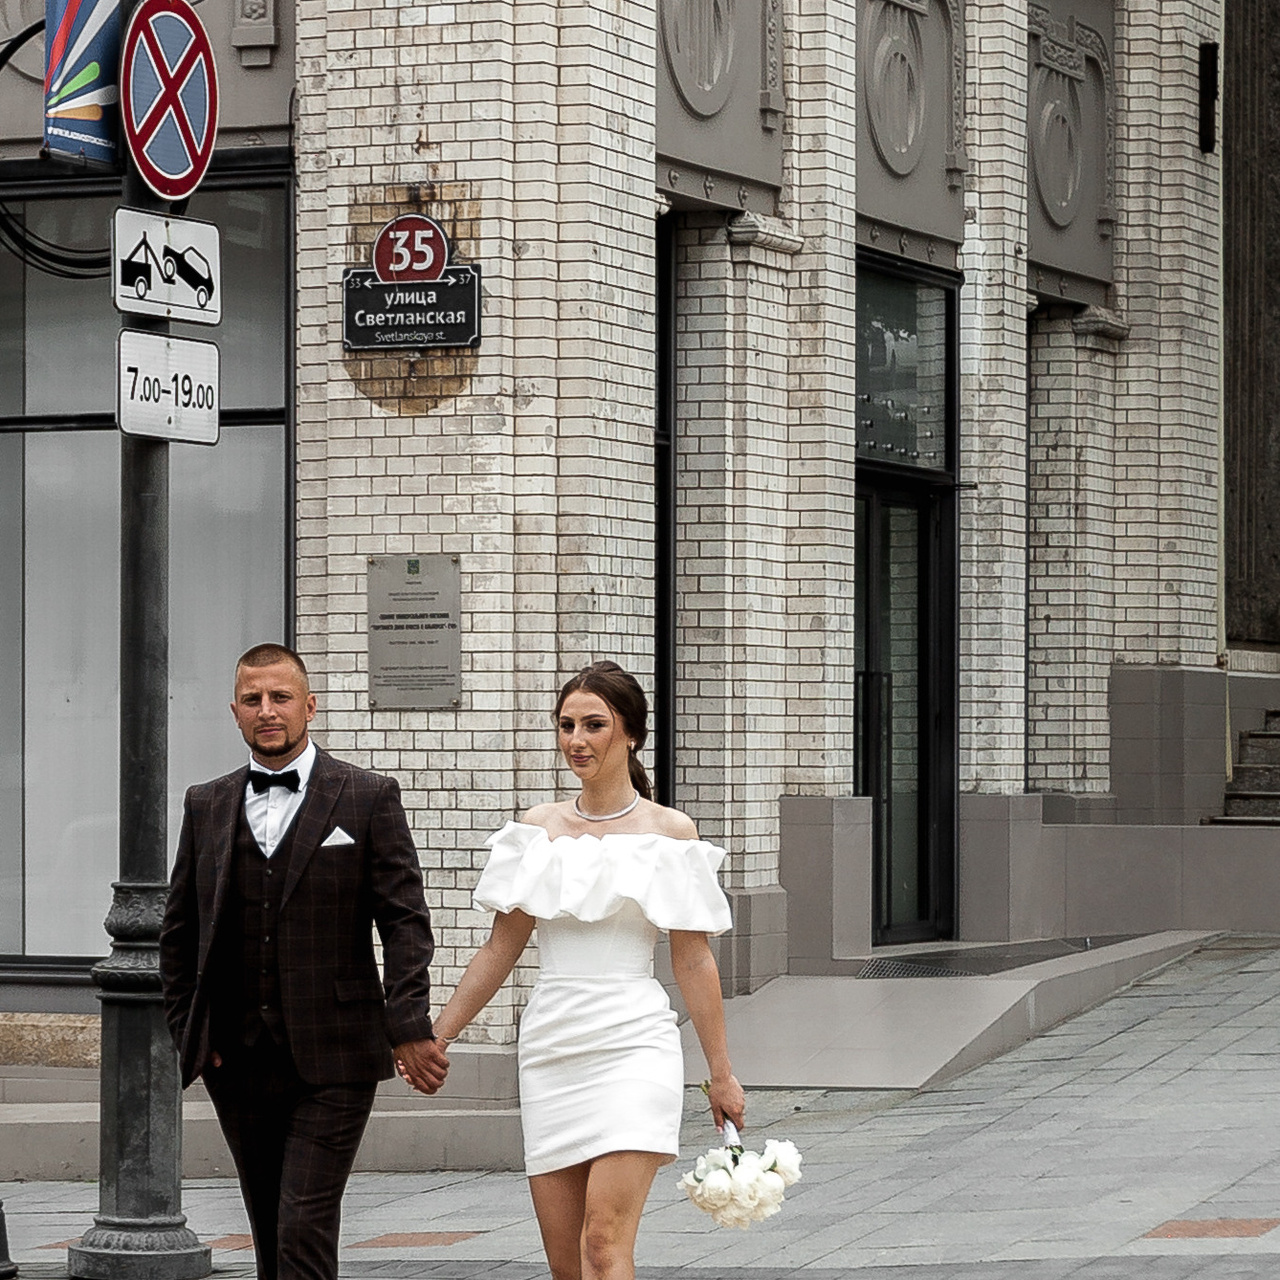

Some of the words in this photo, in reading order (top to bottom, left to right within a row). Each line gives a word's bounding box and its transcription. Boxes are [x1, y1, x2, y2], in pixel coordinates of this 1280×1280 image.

[388, 229, 435, 271] 35
[349, 278, 362, 289] 33
[459, 274, 471, 285] 37
[384, 291, 437, 310] улица
[354, 310, 466, 327] Светланская
[375, 331, 434, 343] Svetlanskaya
